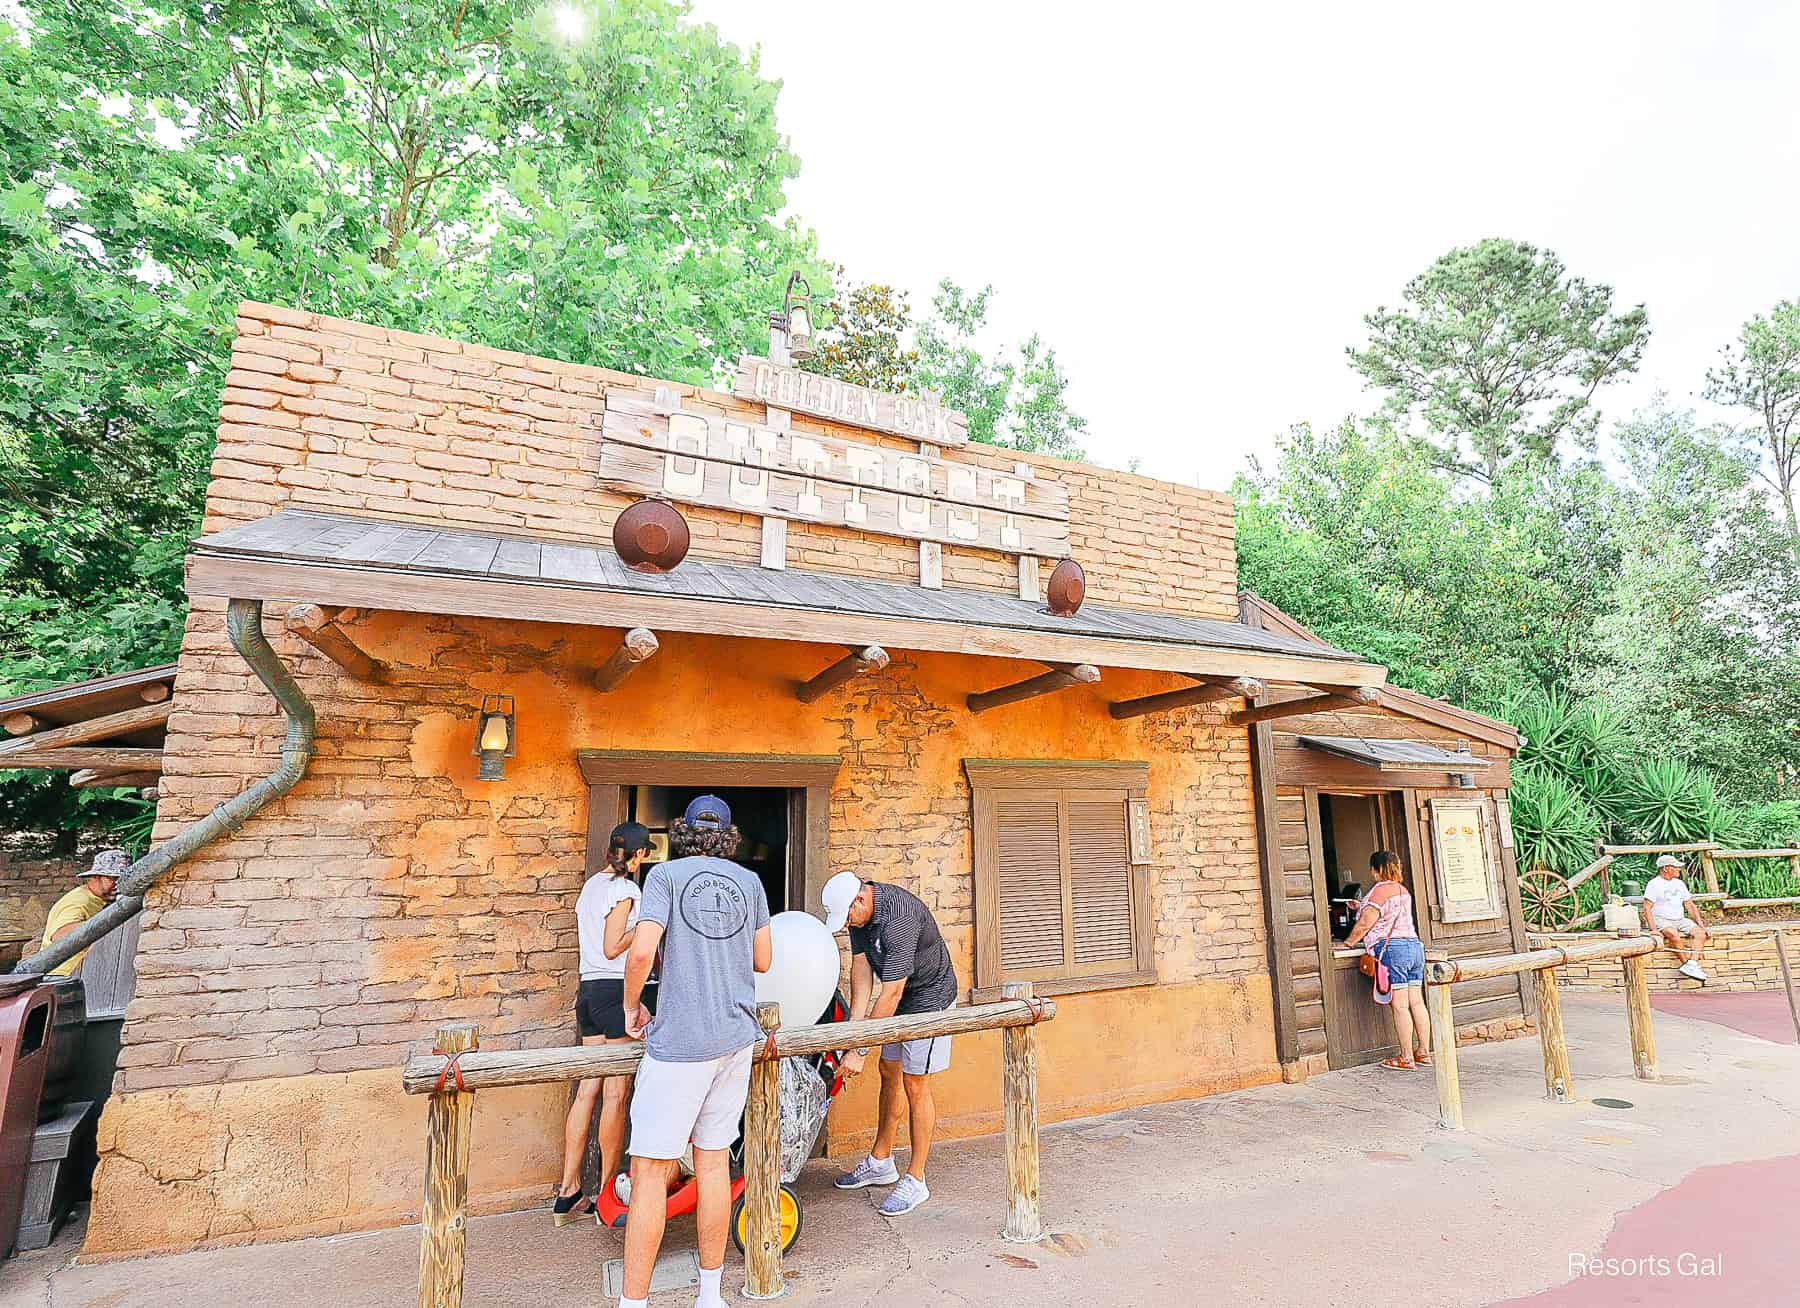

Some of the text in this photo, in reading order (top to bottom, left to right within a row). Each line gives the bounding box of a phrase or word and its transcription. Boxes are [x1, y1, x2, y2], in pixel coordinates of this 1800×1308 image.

[755, 363, 952, 441] GOLDEN OAK
[662, 412, 1026, 549] OUTPOST
[690, 879, 740, 903] YOLO BOARD
